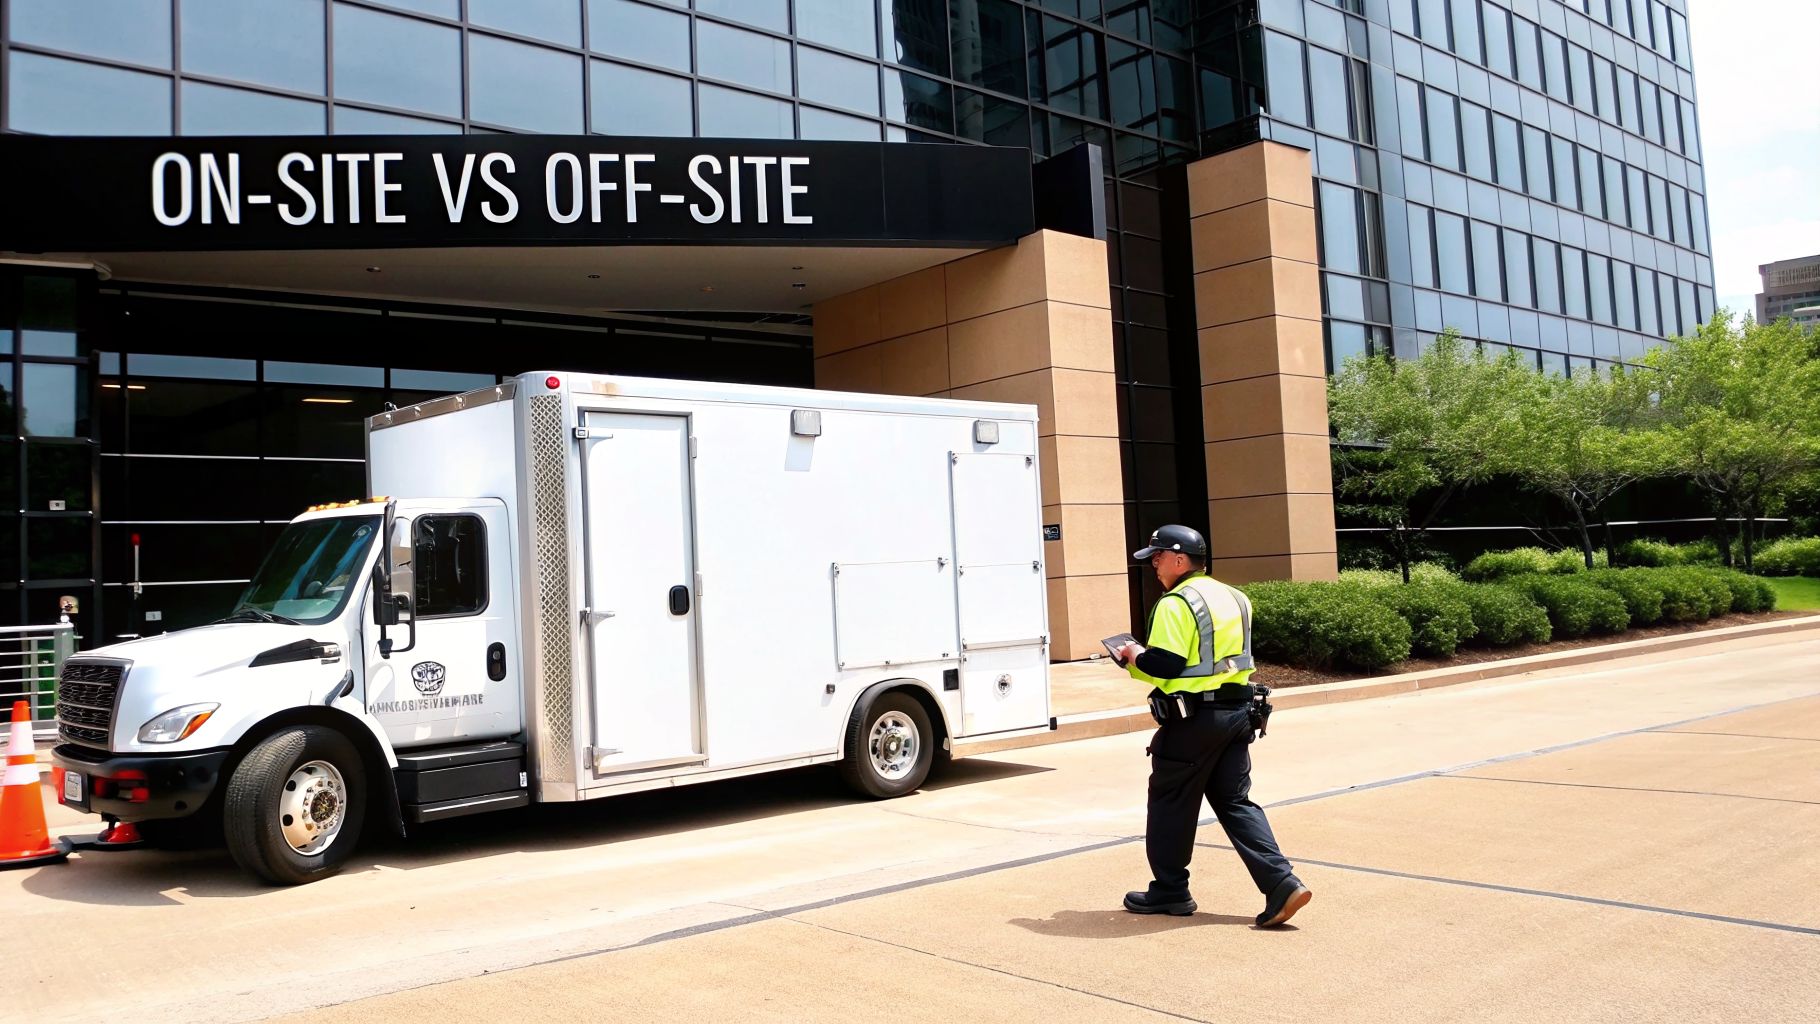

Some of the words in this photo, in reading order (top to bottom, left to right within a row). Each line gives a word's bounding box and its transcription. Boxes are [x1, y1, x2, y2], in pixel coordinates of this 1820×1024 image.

[152, 152, 406, 227] ON-SITE
[431, 152, 519, 224] VS
[545, 152, 813, 225] OFF-SITE
